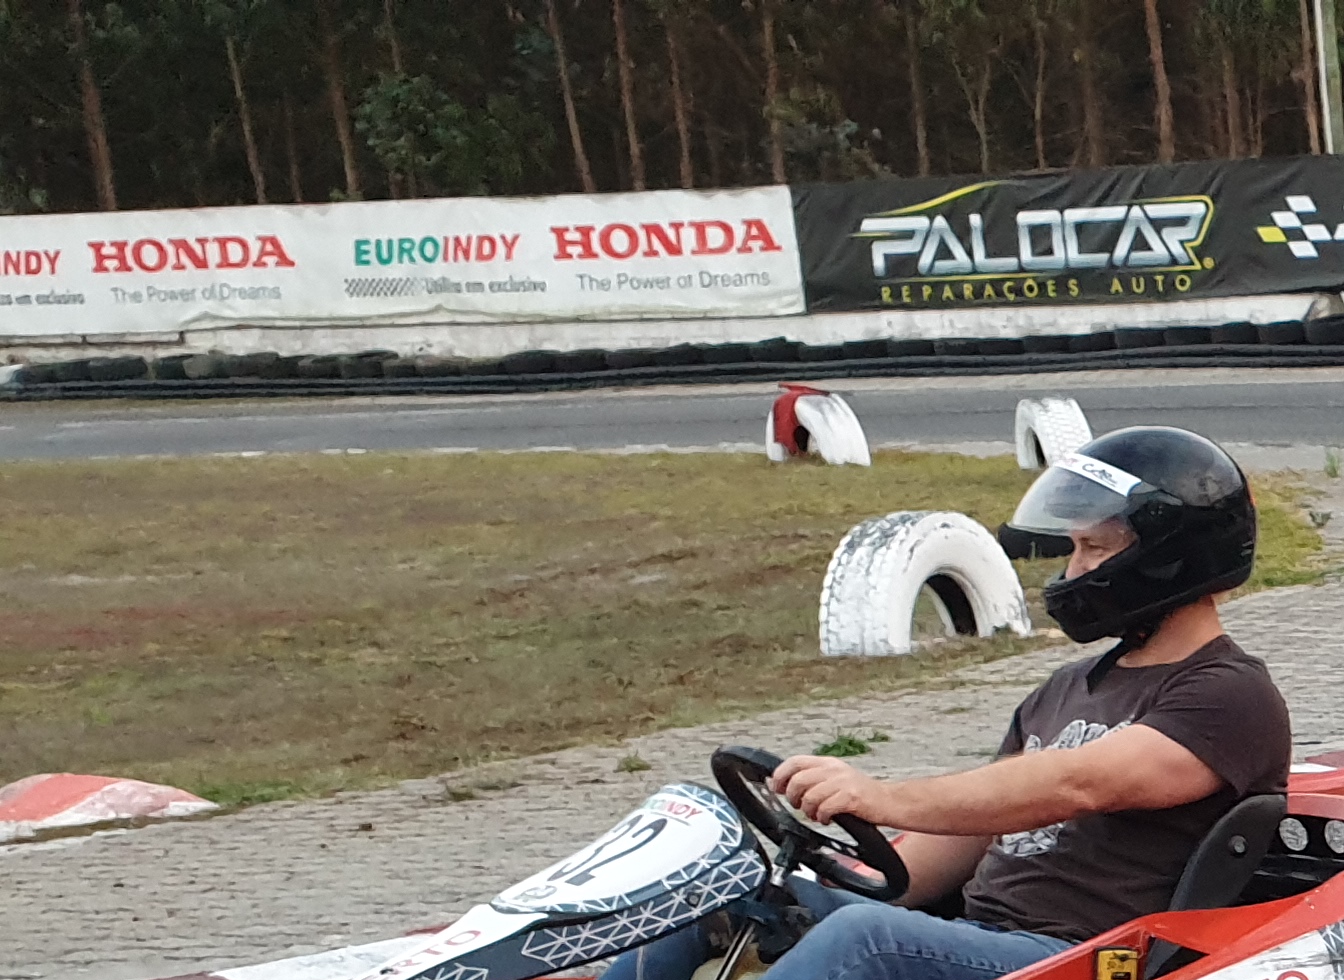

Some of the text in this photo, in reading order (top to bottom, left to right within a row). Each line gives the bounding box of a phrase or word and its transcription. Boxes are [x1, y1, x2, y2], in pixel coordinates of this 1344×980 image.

[87, 235, 296, 273] HONDA
[354, 233, 521, 266] EUROINDY
[550, 218, 783, 261] HONDA
[859, 199, 1208, 276] PALOCAR
[0, 249, 61, 275] NDY
[111, 286, 142, 304] The
[147, 285, 196, 303] Power
[219, 282, 281, 300] Dreams
[576, 270, 771, 292] The Power of Dreams
[882, 272, 1192, 303] REPARAÇÕES AUTO
[547, 813, 668, 886] 32
